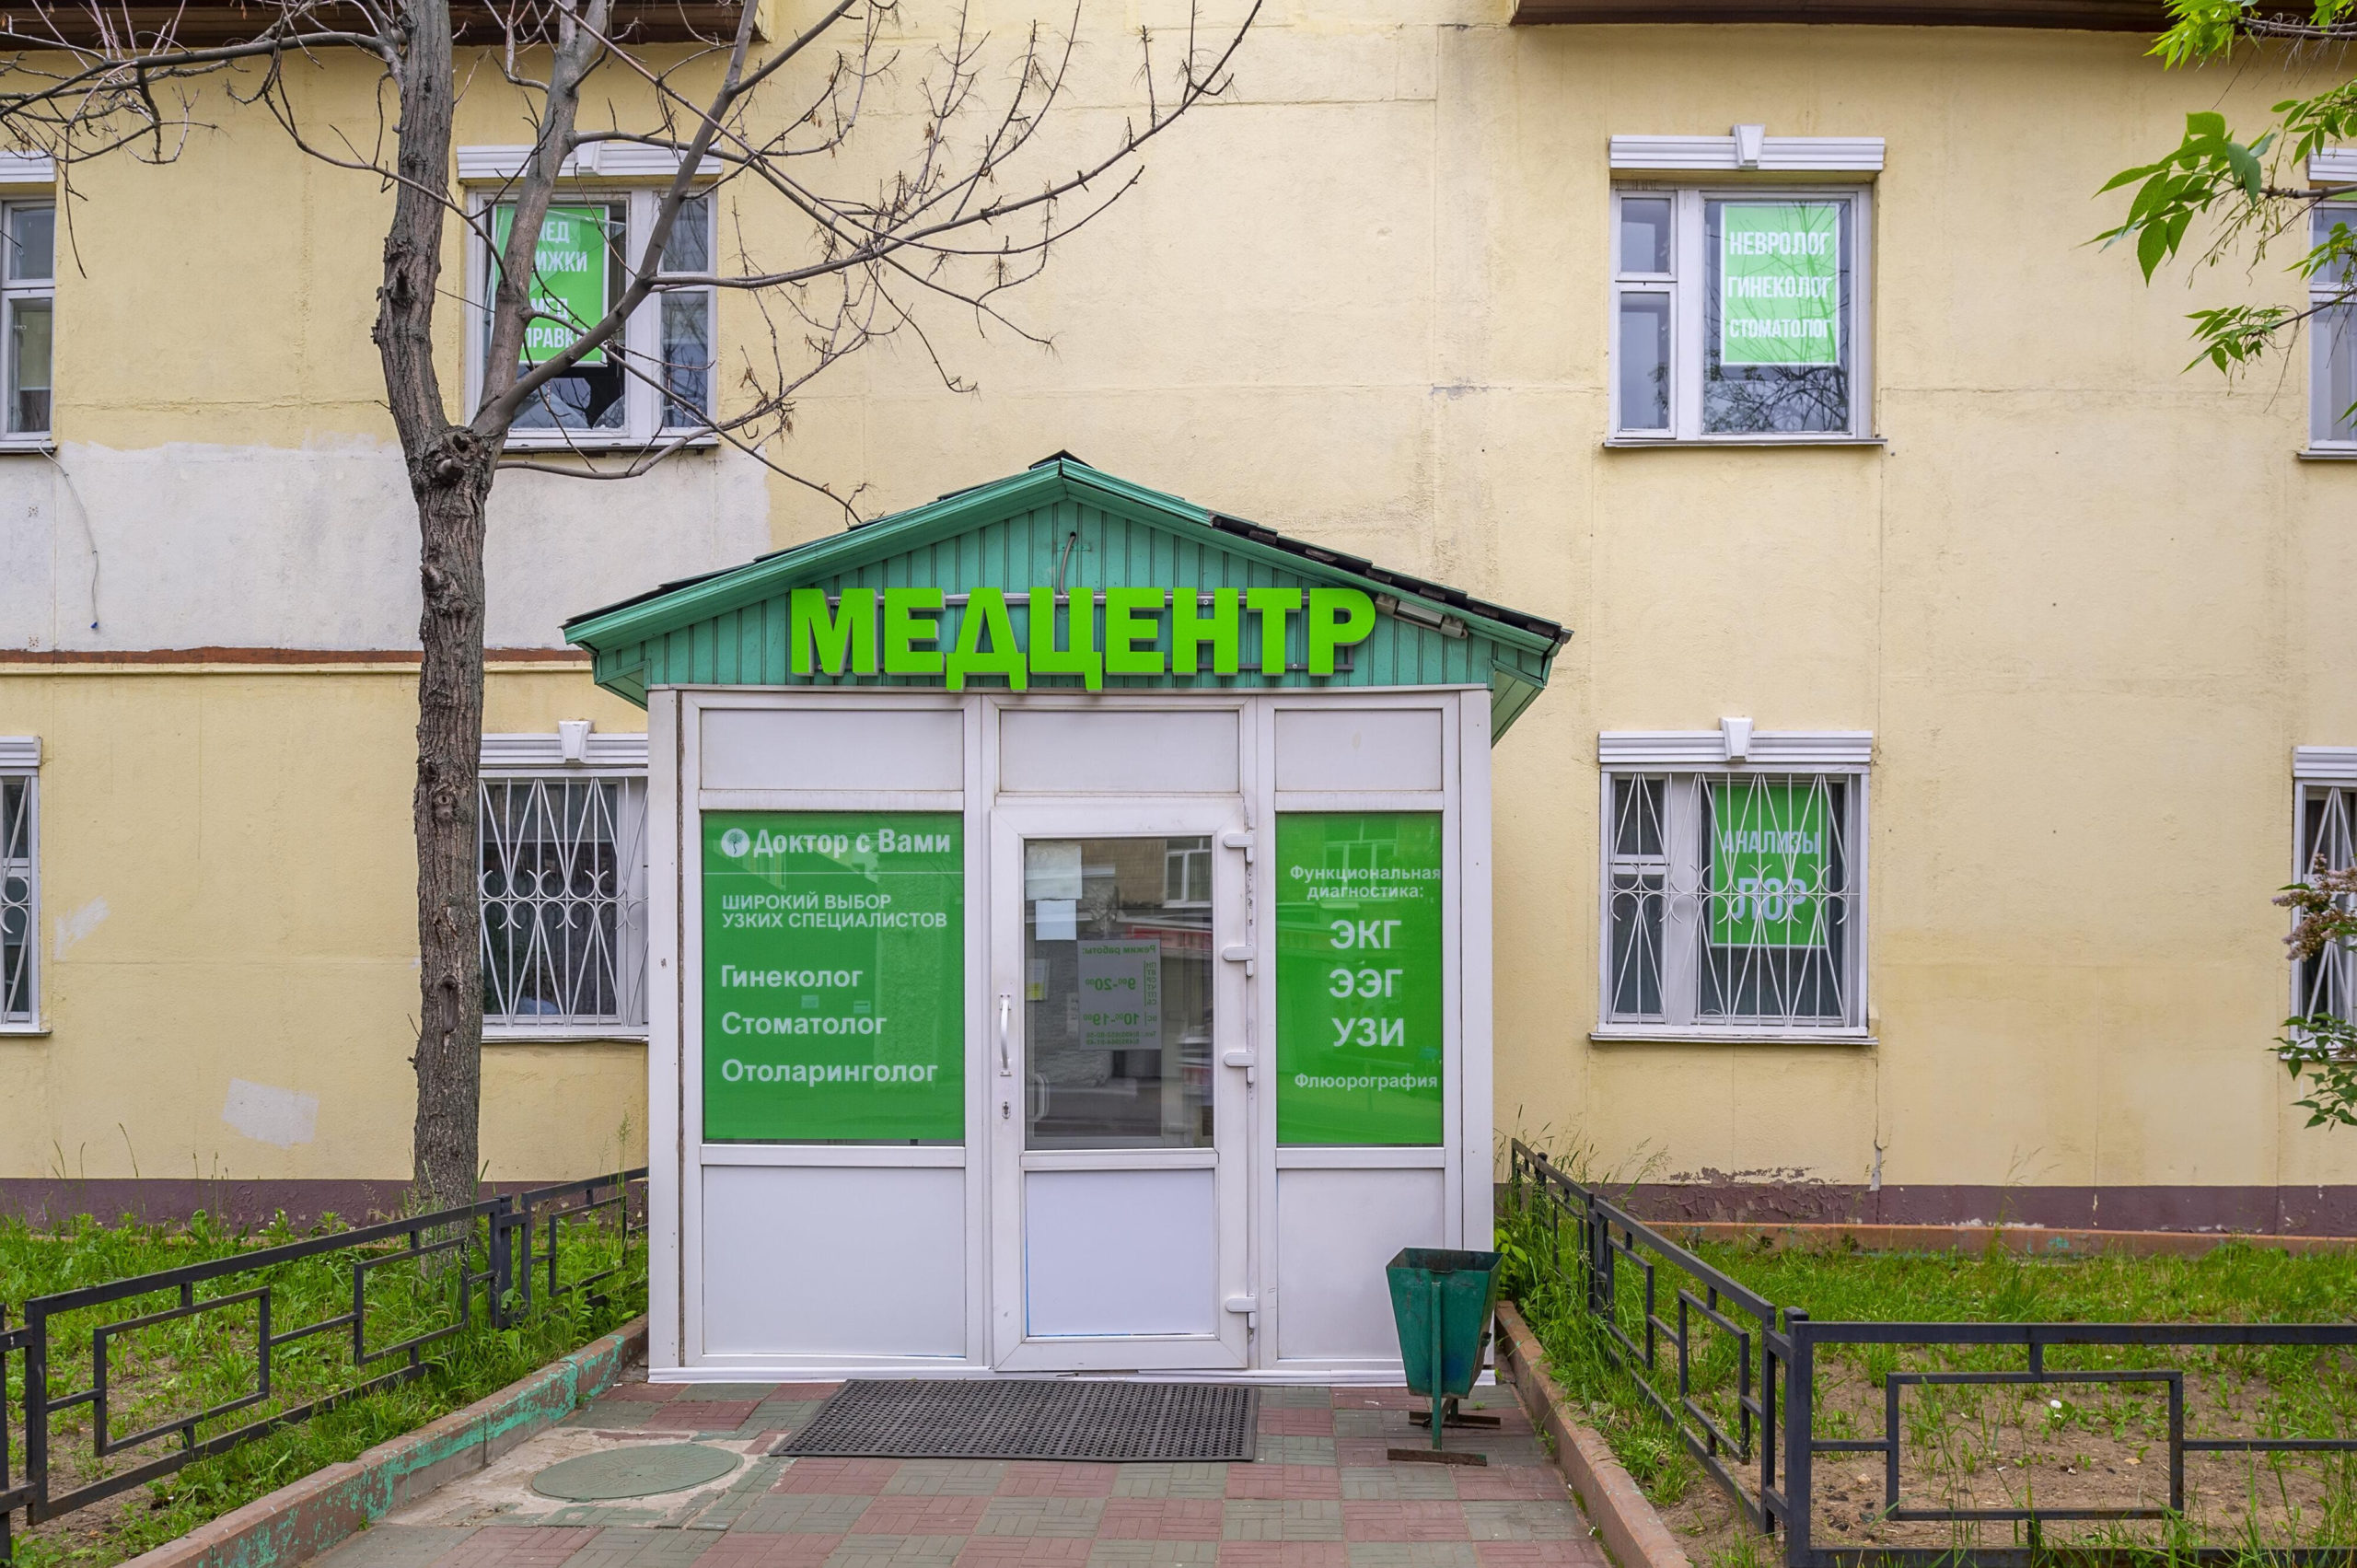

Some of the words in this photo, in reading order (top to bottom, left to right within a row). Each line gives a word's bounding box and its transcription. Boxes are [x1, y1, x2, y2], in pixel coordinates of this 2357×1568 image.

[1729, 231, 1831, 256] НЕВРОЛОГ
[534, 250, 587, 272] ИЖКИ
[1727, 276, 1832, 298] ГИНЕКОЛОГ
[521, 327, 589, 348] ПРАВК
[1729, 319, 1832, 339] СТОМАТОЛОГ
[790, 587, 1376, 691] МЕДЦЕНТР
[753, 829, 848, 858] Доктор
[856, 834, 870, 854] с
[878, 829, 951, 854] Вами
[1722, 830, 1820, 854] АНАЛИЗЫ
[1290, 865, 1442, 883] Функциональная
[722, 891, 819, 910] ШИРОКИЙ
[825, 894, 891, 910] ВЫБОР
[1307, 885, 1424, 900] диагностика:
[1733, 877, 1807, 921] ЛОР
[722, 912, 783, 928] УЗКИХ
[788, 912, 947, 931] СПЕЦИАЛИСТОВ
[1329, 920, 1401, 949] ЭКГ
[722, 964, 864, 987] Гинеколог
[1329, 969, 1403, 998] ЭЭГ
[722, 1012, 888, 1035] Стоматолог
[1331, 1017, 1404, 1047] УЗИ
[722, 1059, 938, 1087] Отоларинголог
[1295, 1073, 1438, 1091] Флюорография
